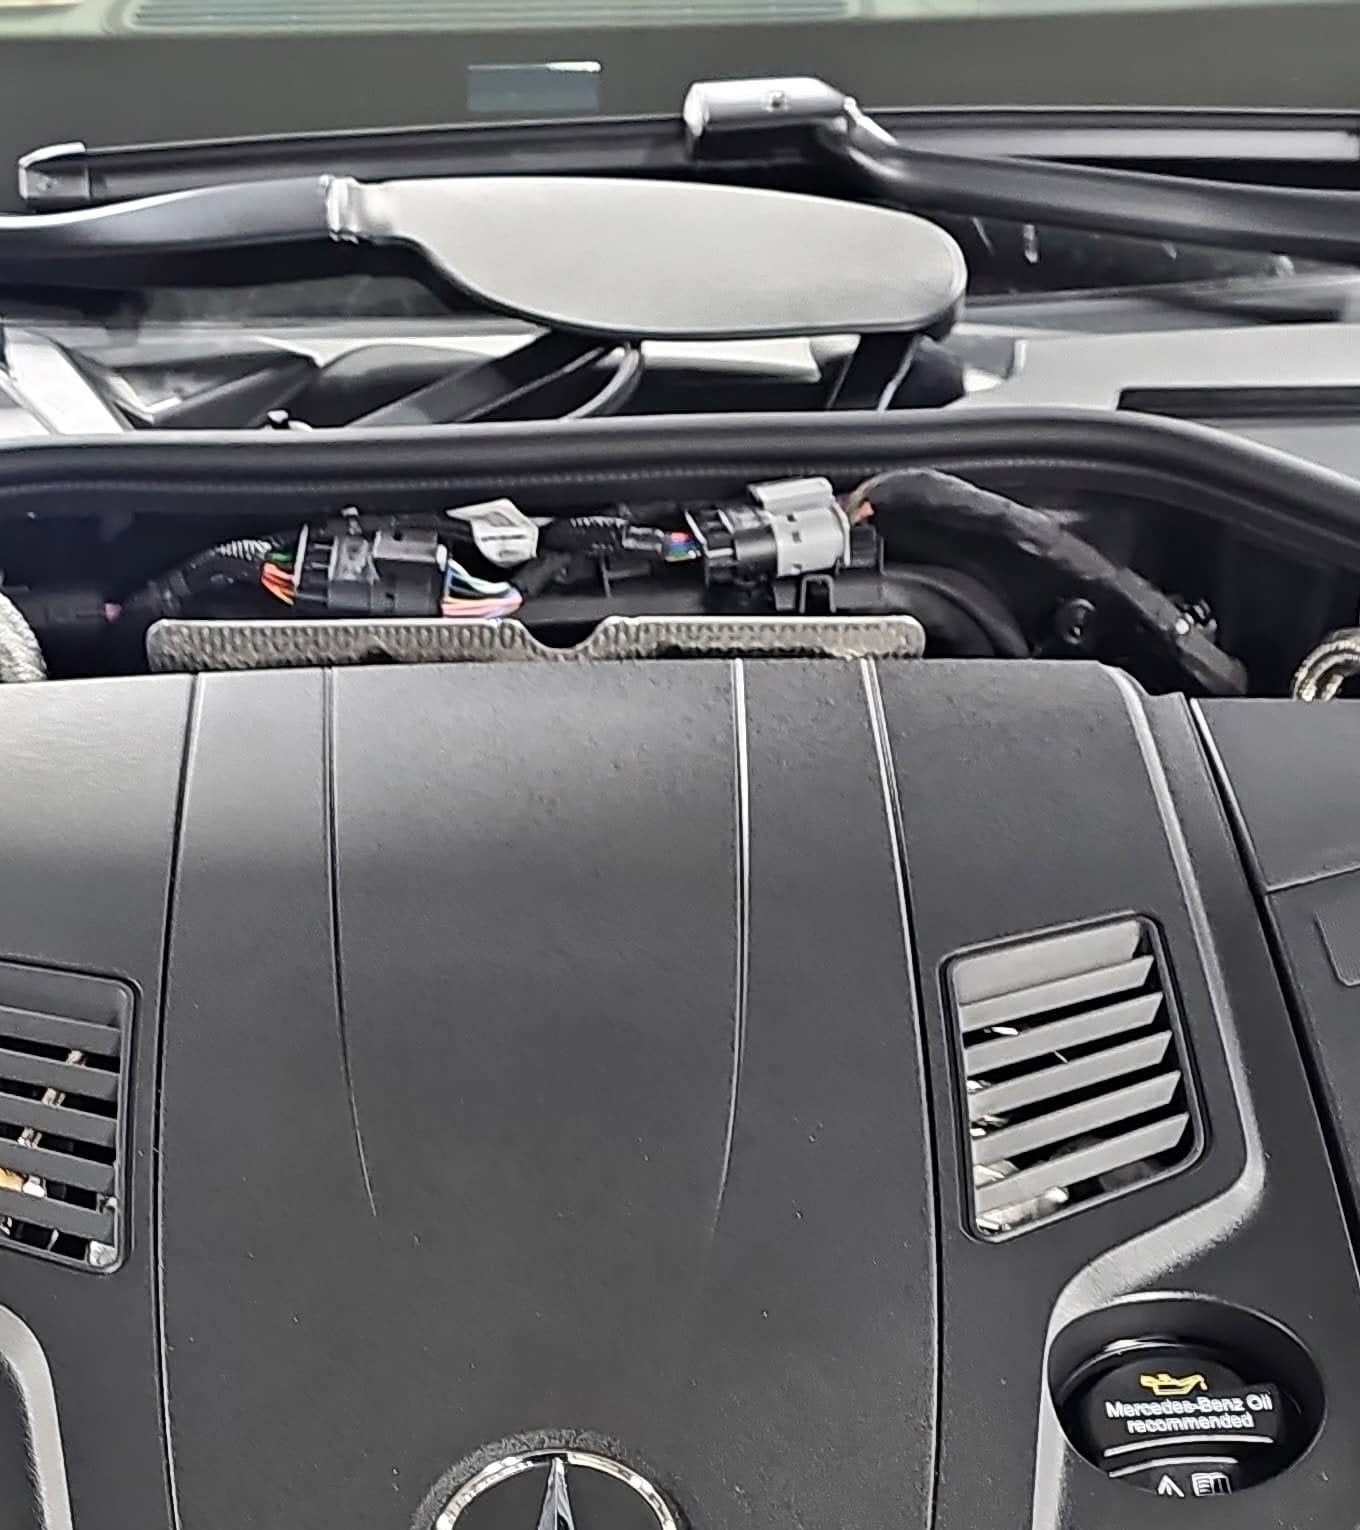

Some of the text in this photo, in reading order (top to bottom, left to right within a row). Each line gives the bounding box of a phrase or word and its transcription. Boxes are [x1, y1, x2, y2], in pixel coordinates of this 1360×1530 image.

[1104, 1393, 1273, 1419] Mercedes-Benz Oil
[1126, 1413, 1255, 1434] recommended
